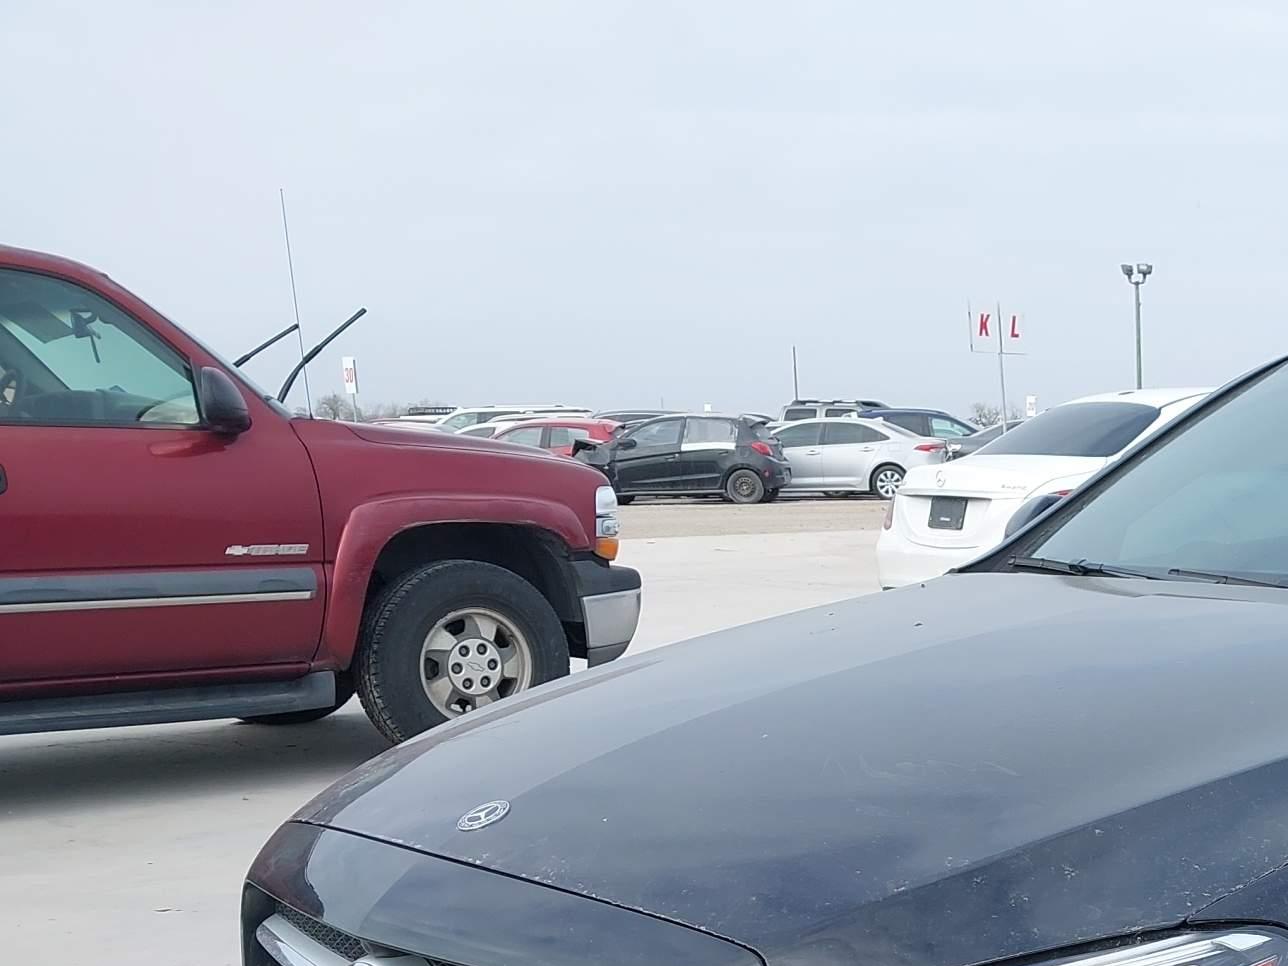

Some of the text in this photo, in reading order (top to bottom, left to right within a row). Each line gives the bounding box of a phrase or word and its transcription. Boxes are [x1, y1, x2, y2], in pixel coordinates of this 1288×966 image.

[979, 313, 990, 337] K
[1010, 315, 1019, 338] L
[345, 367, 354, 383] 30
